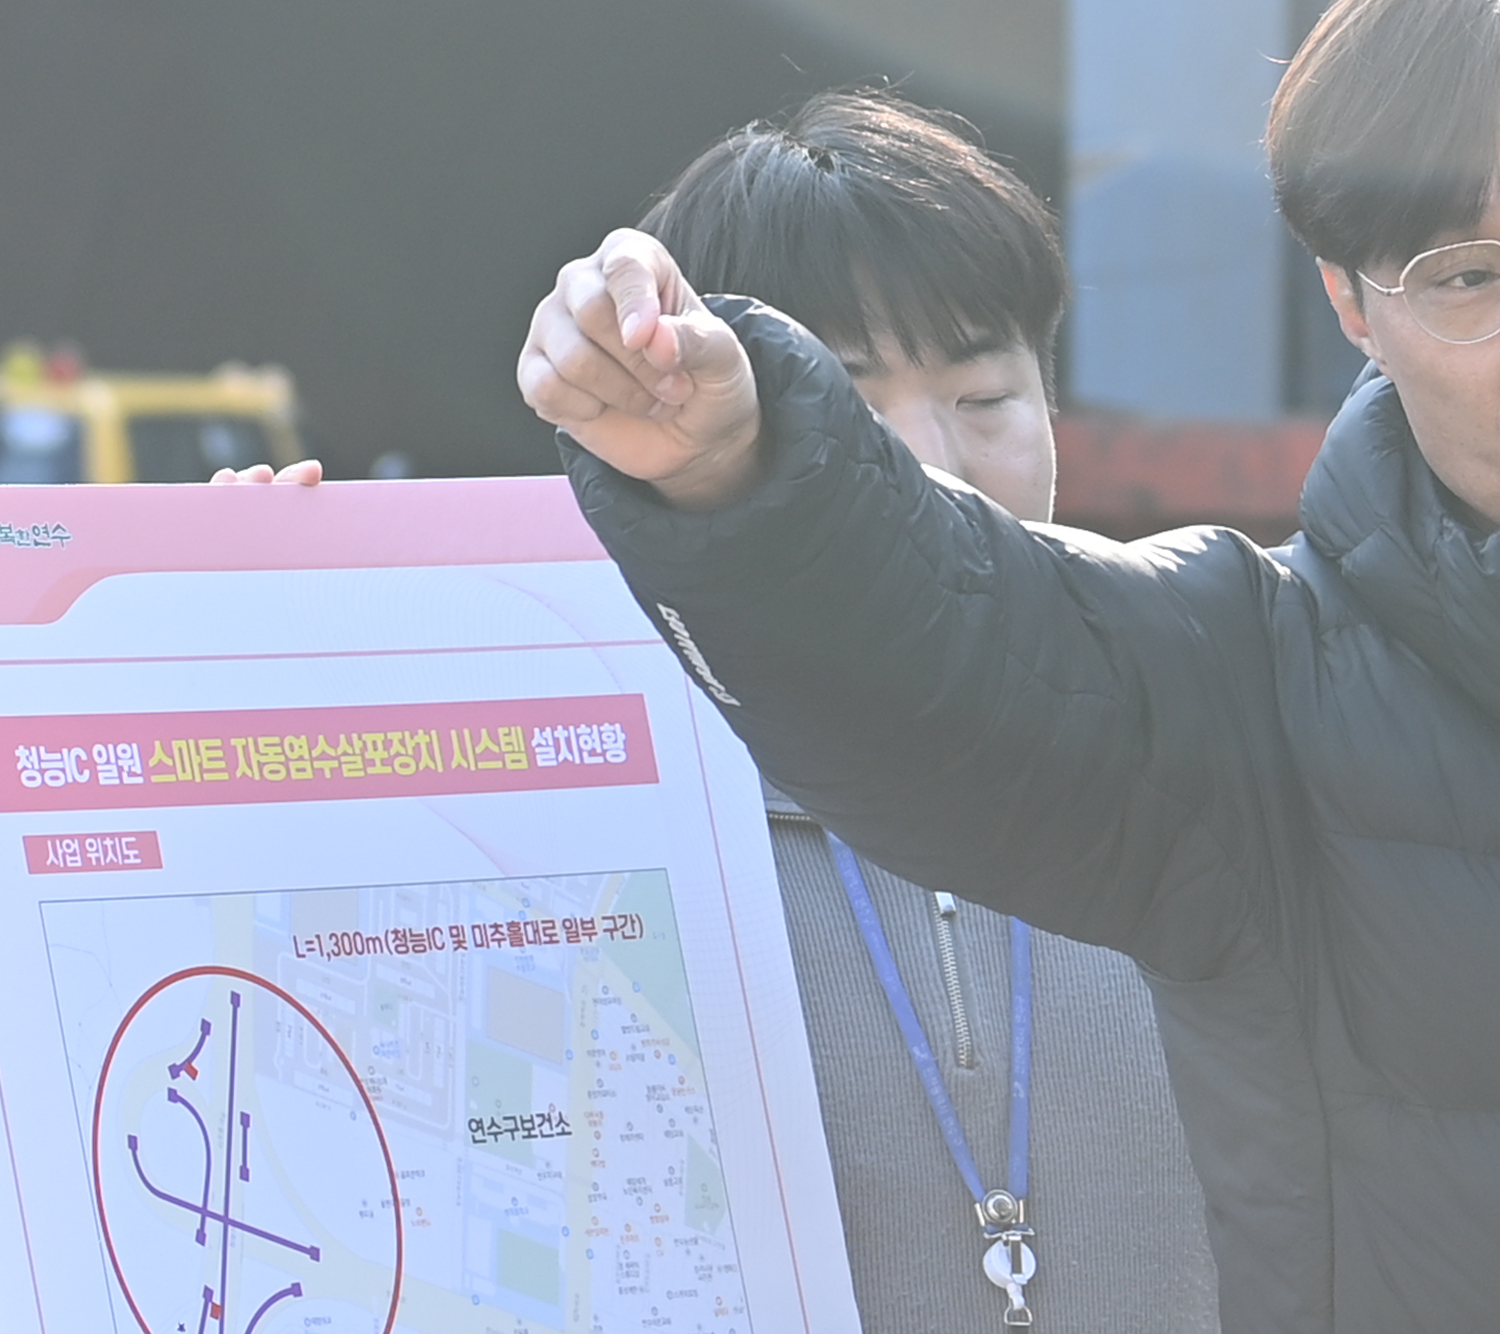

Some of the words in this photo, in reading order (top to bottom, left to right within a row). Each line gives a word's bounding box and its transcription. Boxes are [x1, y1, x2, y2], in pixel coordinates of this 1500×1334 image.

[15, 744, 90, 788] 청능IC
[92, 742, 144, 785] 일원
[149, 738, 229, 783] 스마트
[230, 730, 443, 781] 자동염수살포장치
[450, 726, 529, 771] 시스템
[531, 722, 627, 767] 설치현황
[46, 838, 82, 867] 사업
[86, 837, 141, 866] 위치도
[449, 926, 469, 951] 및
[471, 920, 559, 949] 미추홀대로
[562, 916, 598, 942] 일부
[601, 913, 644, 941] 구간)
[468, 1111, 572, 1144] 연수구보건소
